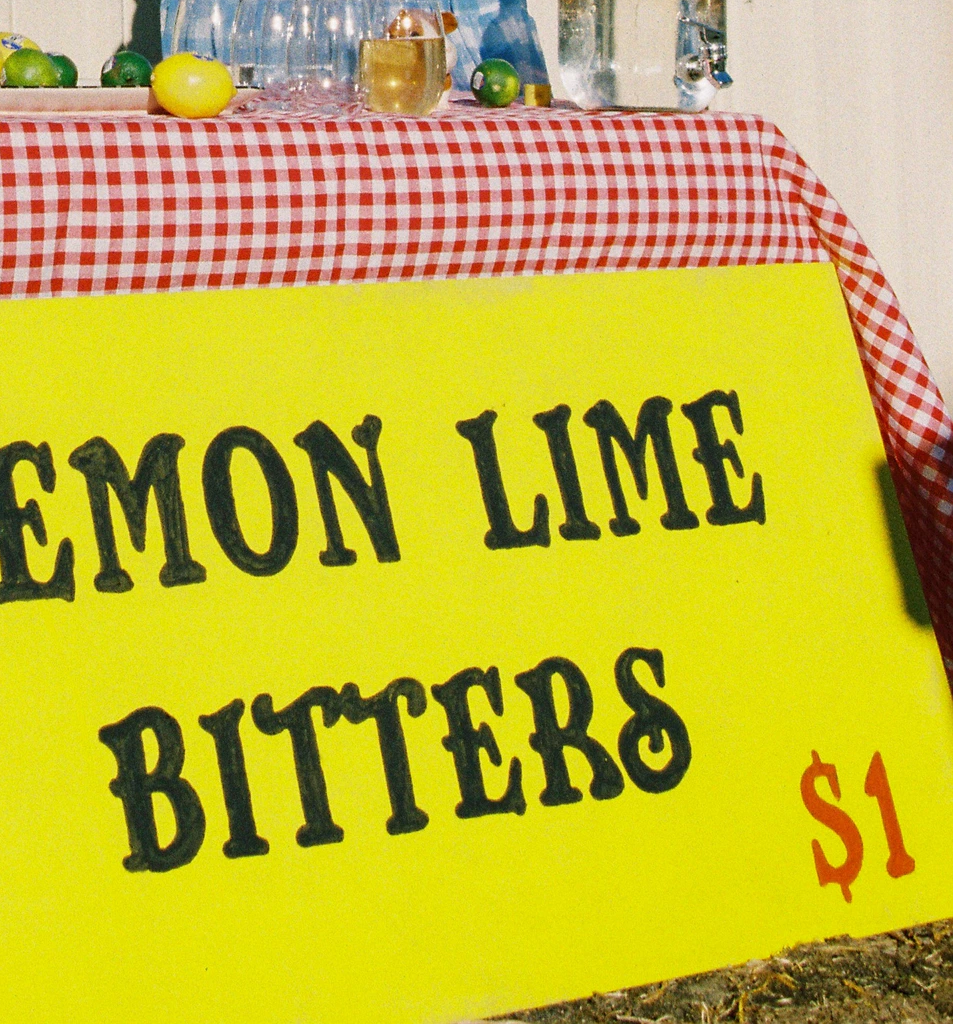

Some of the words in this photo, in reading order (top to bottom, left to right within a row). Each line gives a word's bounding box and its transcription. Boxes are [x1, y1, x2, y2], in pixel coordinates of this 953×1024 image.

[455, 390, 767, 551] LIME
[98, 647, 692, 874] BITTERS
[800, 749, 916, 903] $1
